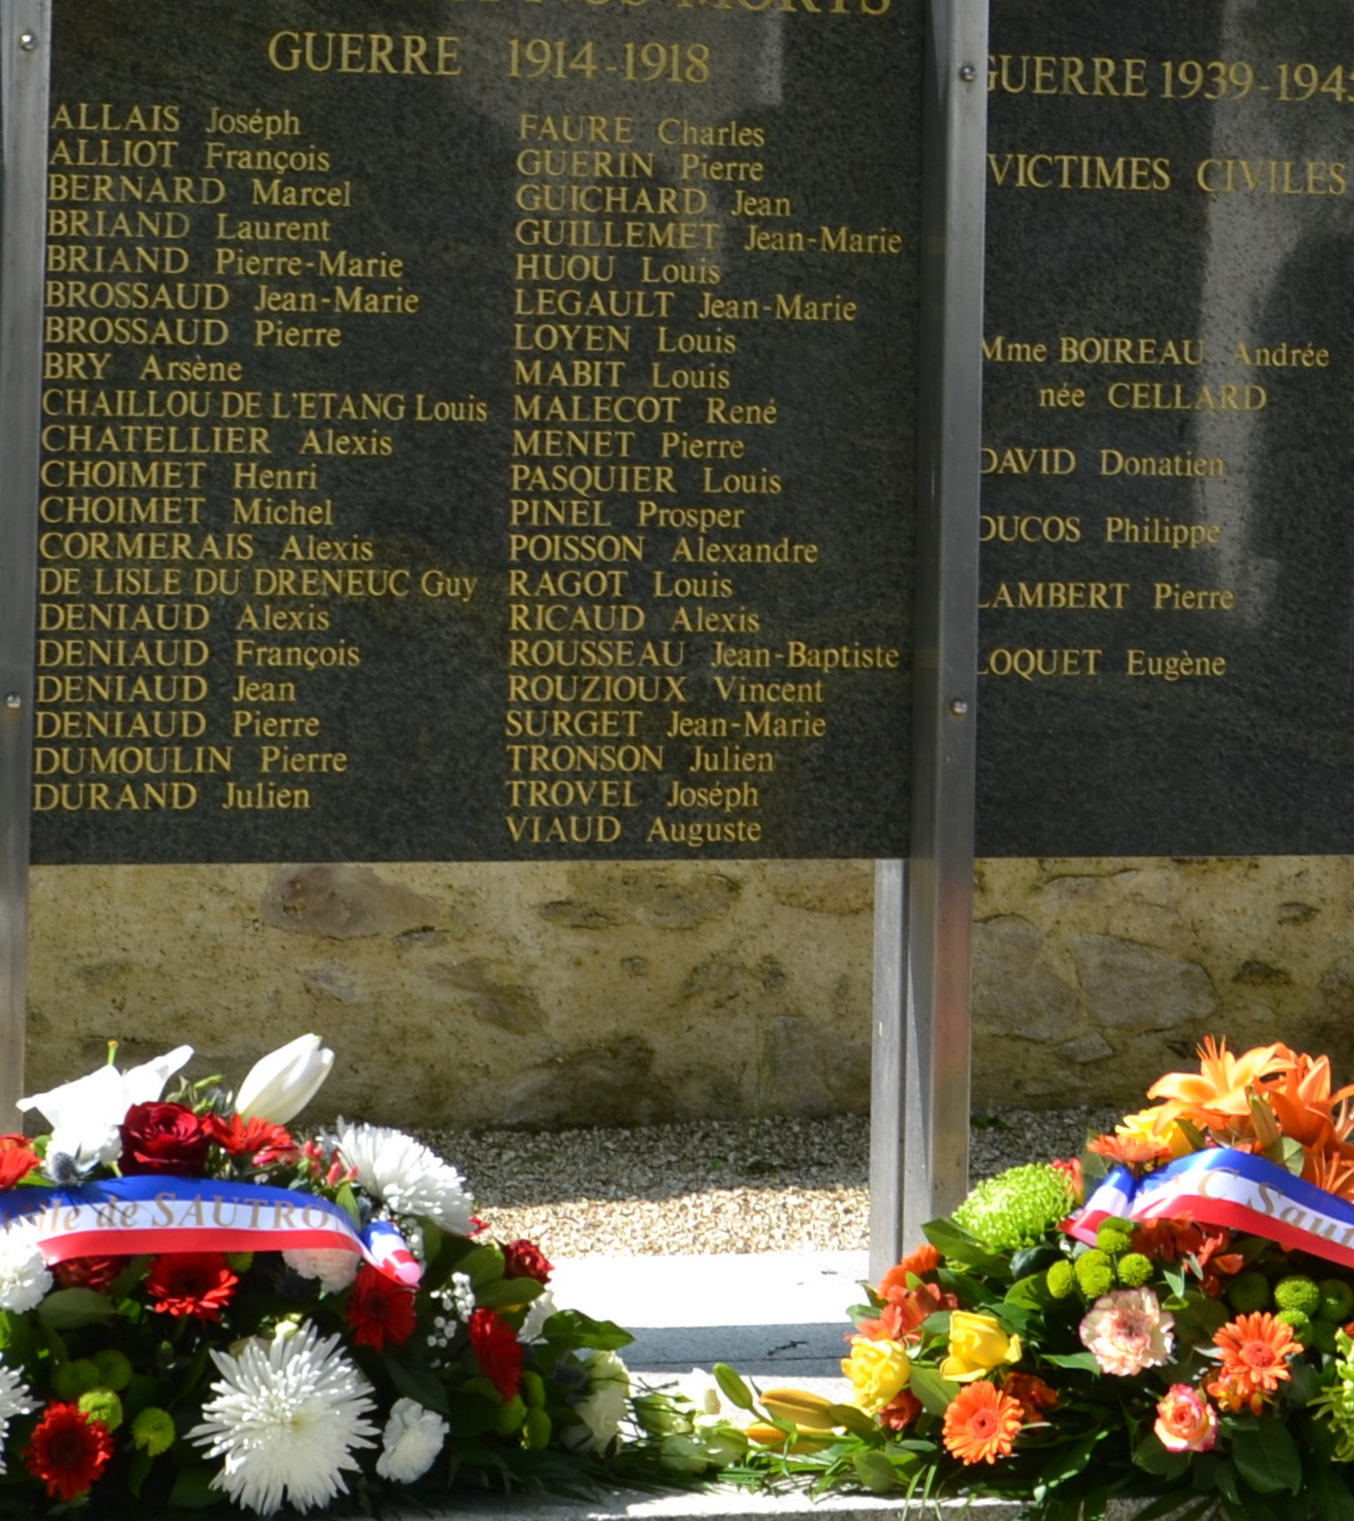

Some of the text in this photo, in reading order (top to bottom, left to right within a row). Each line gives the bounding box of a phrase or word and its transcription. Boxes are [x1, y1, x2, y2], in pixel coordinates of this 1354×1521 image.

[267, 30, 462, 76] GUERRE
[51, 102, 301, 137] ALLAIS Joséph
[520, 113, 765, 148] FAURE Charles
[49, 138, 331, 175] ALLIOT François
[516, 148, 764, 182] GUERIN Pierre
[48, 173, 351, 207] BERNARD Marcel
[987, 153, 1347, 196] VICTIMES CIVILES
[515, 183, 792, 217] GUICHARD Jean
[48, 209, 331, 242] BRIAND Laurent
[515, 218, 902, 254] GUILLEMET Jean-Marie
[47, 244, 404, 279] BRIAND Pierre-Marie
[515, 253, 721, 285] HUOU Louis
[46, 280, 420, 314] BROSSAUD Jean-Marie
[514, 287, 857, 322] LEGAULT Jean-Marie
[45, 316, 342, 348] BROSSAUD Pierre
[514, 323, 737, 354] LOYEN Louis
[44, 351, 243, 382] BRY Arsène
[1060, 336, 1208, 366] BOIREAU
[1229, 341, 1331, 369] Andrée
[514, 359, 731, 390] MABIT Louis
[42, 388, 212, 418] CHAILLOU
[221, 390, 262, 419] DE
[415, 393, 488, 422] Louis
[514, 394, 777, 425] MALECOT René
[1039, 382, 1268, 410] née CELLARD
[41, 424, 393, 456] CHATELLIER Alexis
[512, 429, 745, 459] MENET Pierre
[40, 459, 318, 490] CHOIMET Henri
[1099, 449, 1227, 478] Donatien
[511, 463, 782, 498] PASQUIER Louis
[39, 495, 334, 526] CHOIMET Michel
[510, 498, 745, 534] PINEL Prosper
[39, 531, 374, 562] CORMERAIS Alexis
[509, 533, 819, 564] POISSON Alexandre
[1105, 516, 1221, 550] Philippe
[39, 567, 478, 603] DE LISLE DU DRENEUC Guy
[508, 569, 734, 598] RAGOT Louis
[1154, 582, 1235, 611] Pierre
[39, 603, 330, 631] DENIAUD Alexis
[510, 603, 761, 633] RICAUD Alexis
[39, 638, 361, 671] DENIAUD François
[509, 638, 899, 674] ROUSSEAU Jean-Baptiste
[1126, 649, 1227, 682] Eugène
[37, 674, 296, 703] DENIAUD Jean
[508, 674, 824, 703] ROUZIOUX Vincent
[36, 710, 320, 739] DENIAUD Pierre
[505, 709, 826, 738] SURGET Jean-Marie
[35, 745, 348, 775] DUMOULIN Pierre
[506, 744, 774, 773] TRONSON Julien
[33, 781, 310, 811] DURAND Julien
[505, 779, 643, 808] TROVEL
[505, 815, 762, 848] VIAUD Auguste
[96, 1193, 139, 1229] de
